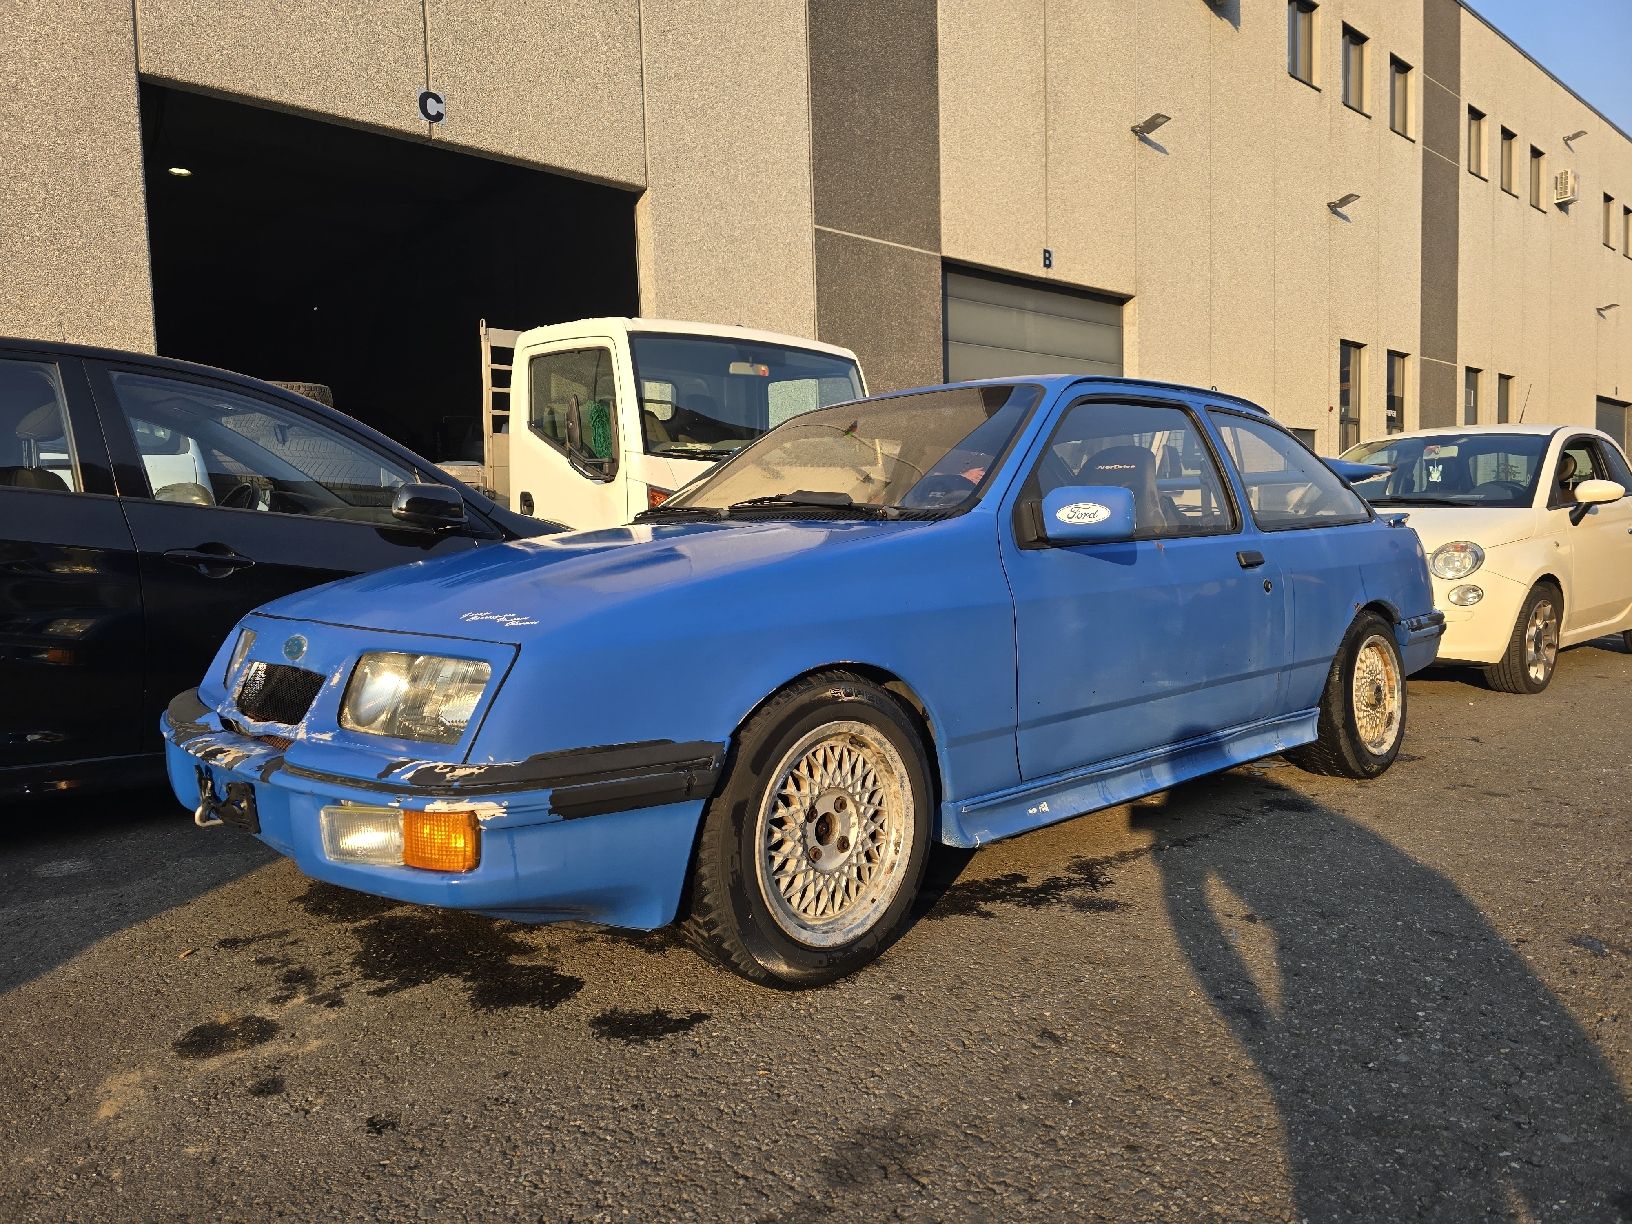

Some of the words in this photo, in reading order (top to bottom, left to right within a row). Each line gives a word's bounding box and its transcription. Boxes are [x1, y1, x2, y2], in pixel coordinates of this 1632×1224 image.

[418, 91, 444, 122] C
[1043, 249, 1052, 268] B
[1066, 506, 1099, 519] Ford
